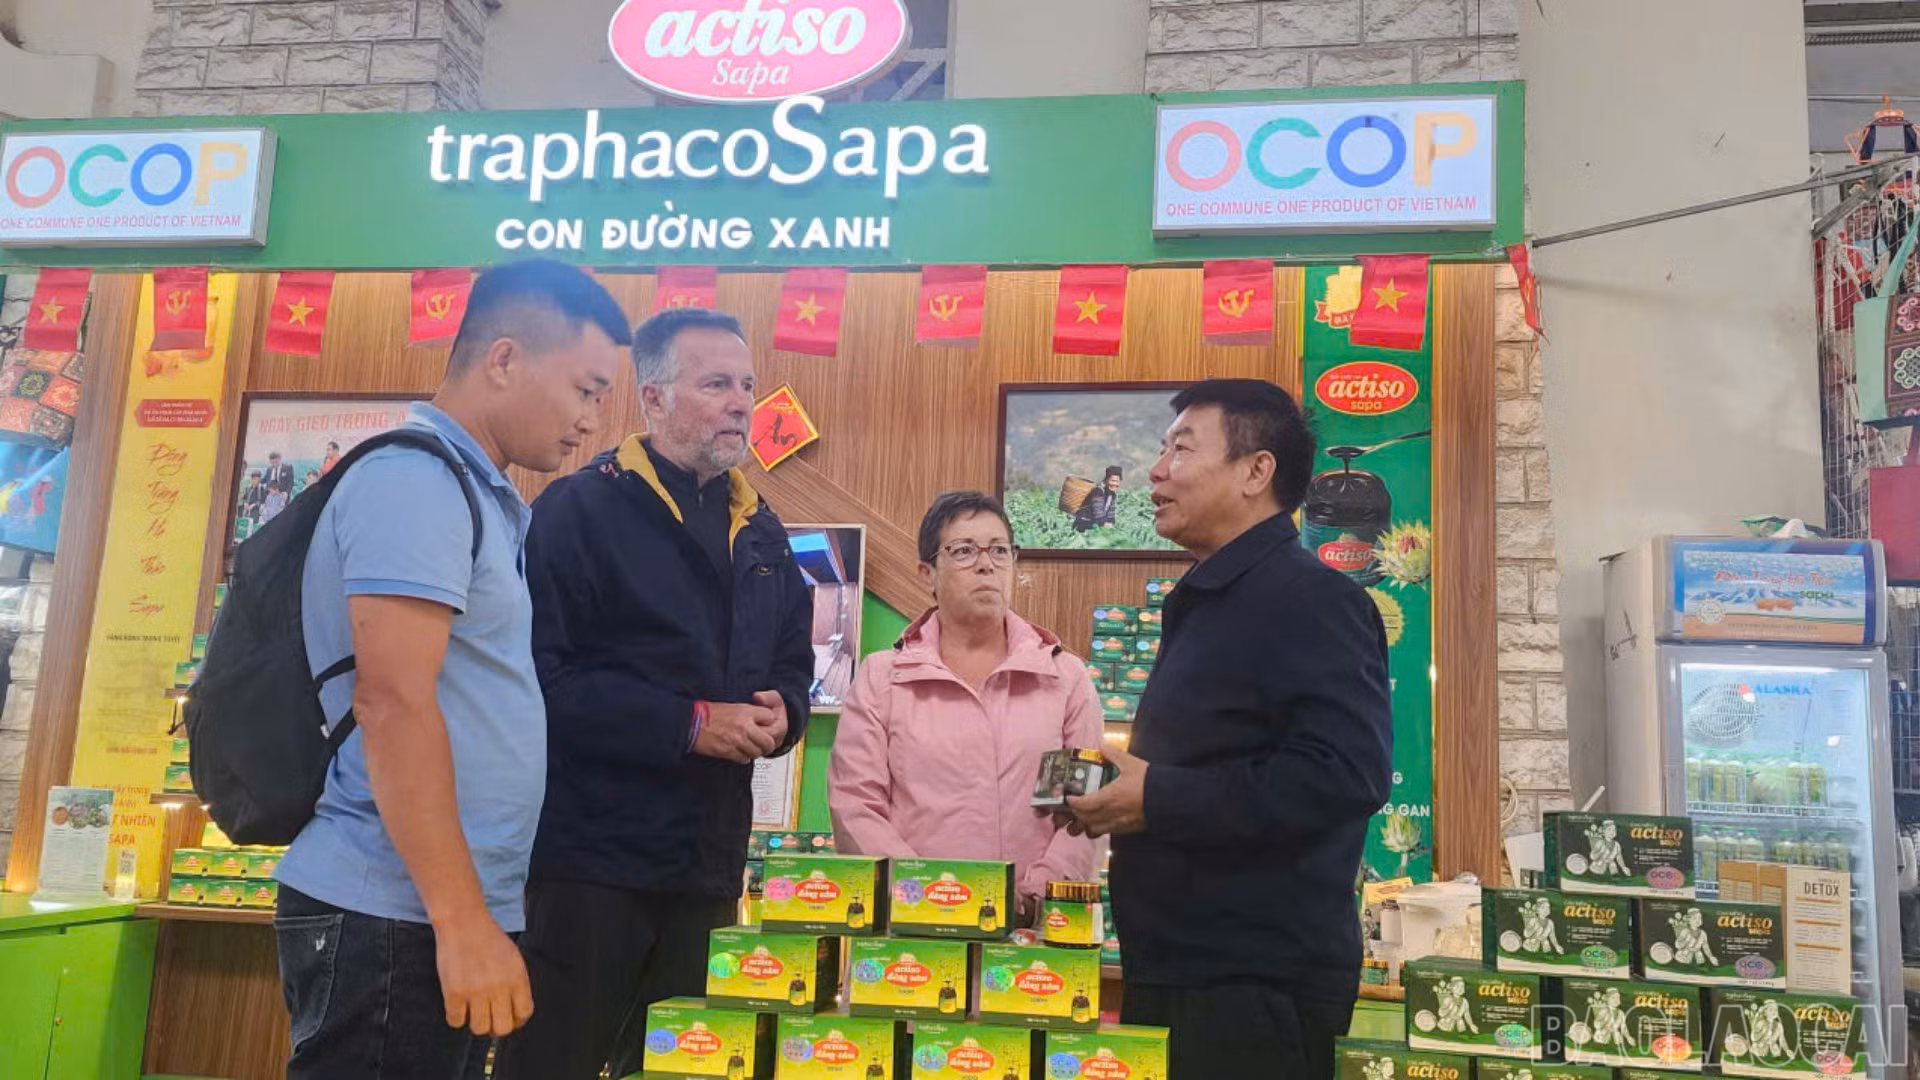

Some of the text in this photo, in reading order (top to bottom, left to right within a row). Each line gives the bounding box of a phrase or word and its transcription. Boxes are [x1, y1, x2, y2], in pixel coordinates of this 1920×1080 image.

[644, 0, 867, 57] actiso
[711, 58, 790, 94] Sapa
[427, 95, 989, 201] traphacoSapa
[1165, 111, 1477, 192] OCOP
[5, 143, 247, 207] OCOP
[1166, 196, 1477, 216] ONE COMMUNE ONE PRODUCT OF VIETNAM
[1, 214, 241, 229] ONE COMMUNE ONE PRODUCT OF VIETNAM
[495, 201, 890, 250] CON ĐƯỜNG XANH
[1328, 373, 1405, 398] actiso
[1350, 401, 1382, 411] sapa
[1398, 803, 1431, 817] GAN
[1631, 823, 1683, 841] actiso
[1804, 881, 1840, 897] DETOX
[1564, 903, 1616, 920] actiso
[1717, 912, 1773, 929] actiso
[1478, 982, 1531, 998] actiso
[1407, 1063, 1459, 1080] actiso
